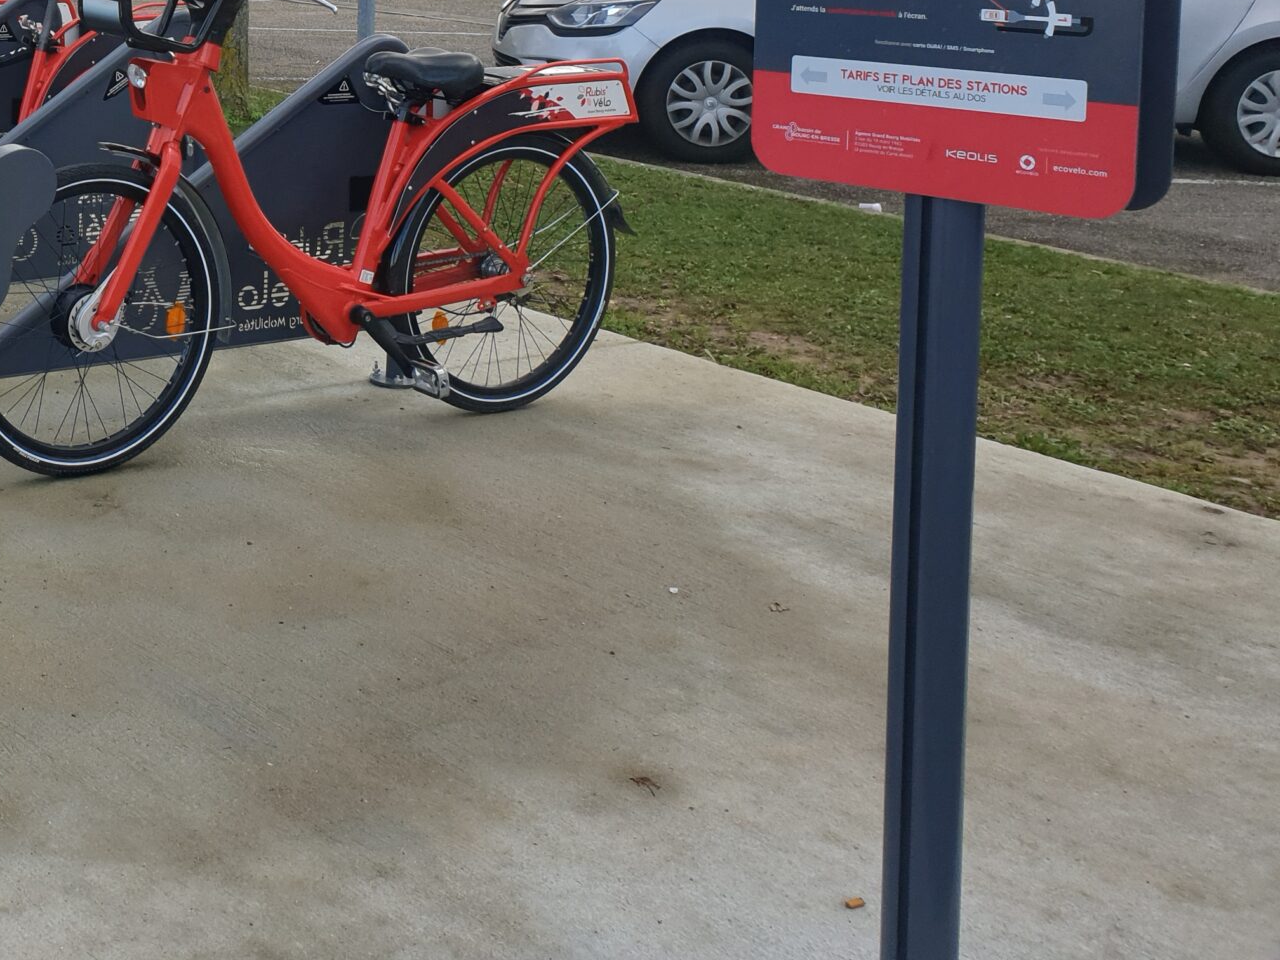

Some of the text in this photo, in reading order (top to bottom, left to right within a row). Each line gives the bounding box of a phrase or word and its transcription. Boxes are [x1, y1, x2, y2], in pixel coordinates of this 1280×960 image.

[841, 69, 1028, 96] TARIFS ET PLAN DES STATIONS
[592, 96, 612, 107] Vélo
[877, 84, 987, 103] VOIR LES DÉTAILS AU DOS
[1053, 164, 1108, 178] ecovelo.com
